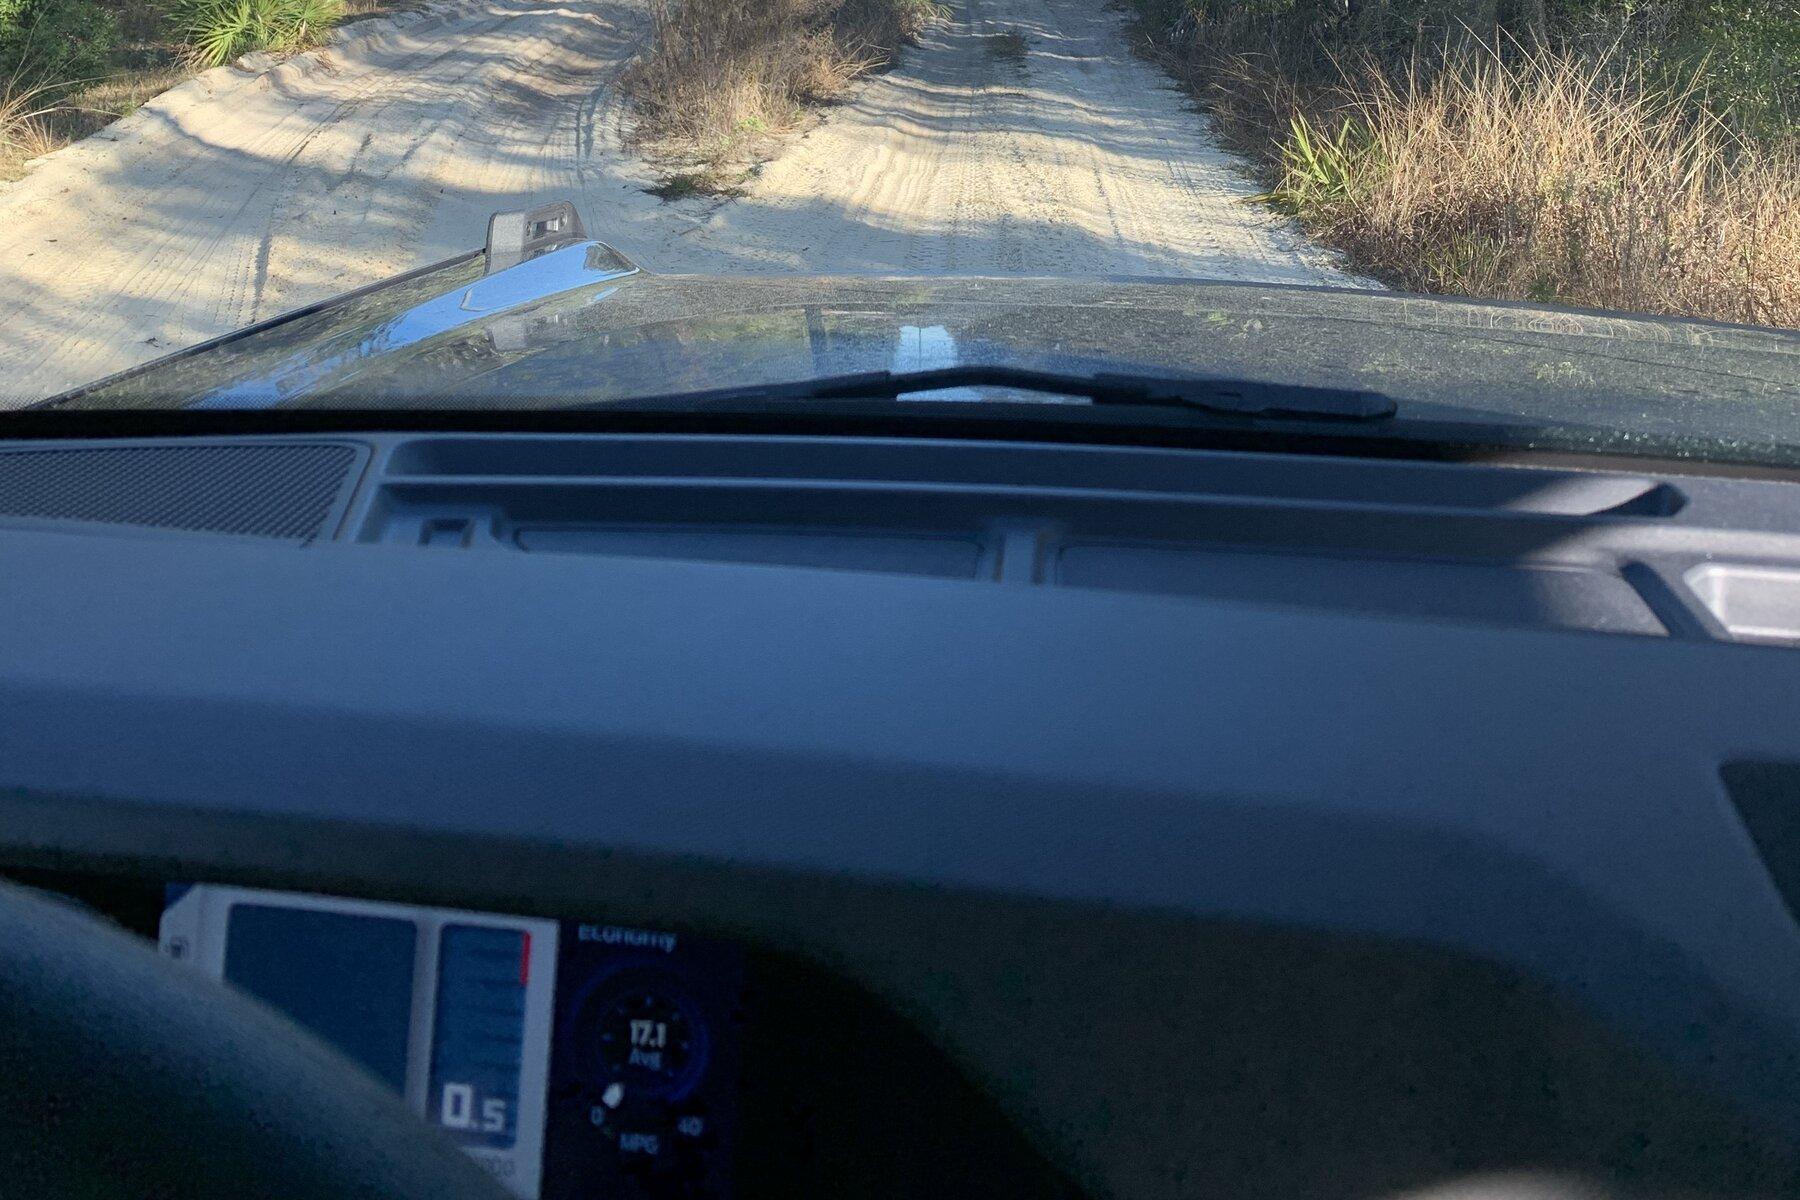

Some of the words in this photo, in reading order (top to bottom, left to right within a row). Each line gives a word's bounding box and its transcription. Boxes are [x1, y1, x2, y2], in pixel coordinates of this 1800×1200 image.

[630, 1019, 667, 1048] 17.1
[441, 1082, 506, 1132] 0.5
[619, 1131, 659, 1155] MPG
